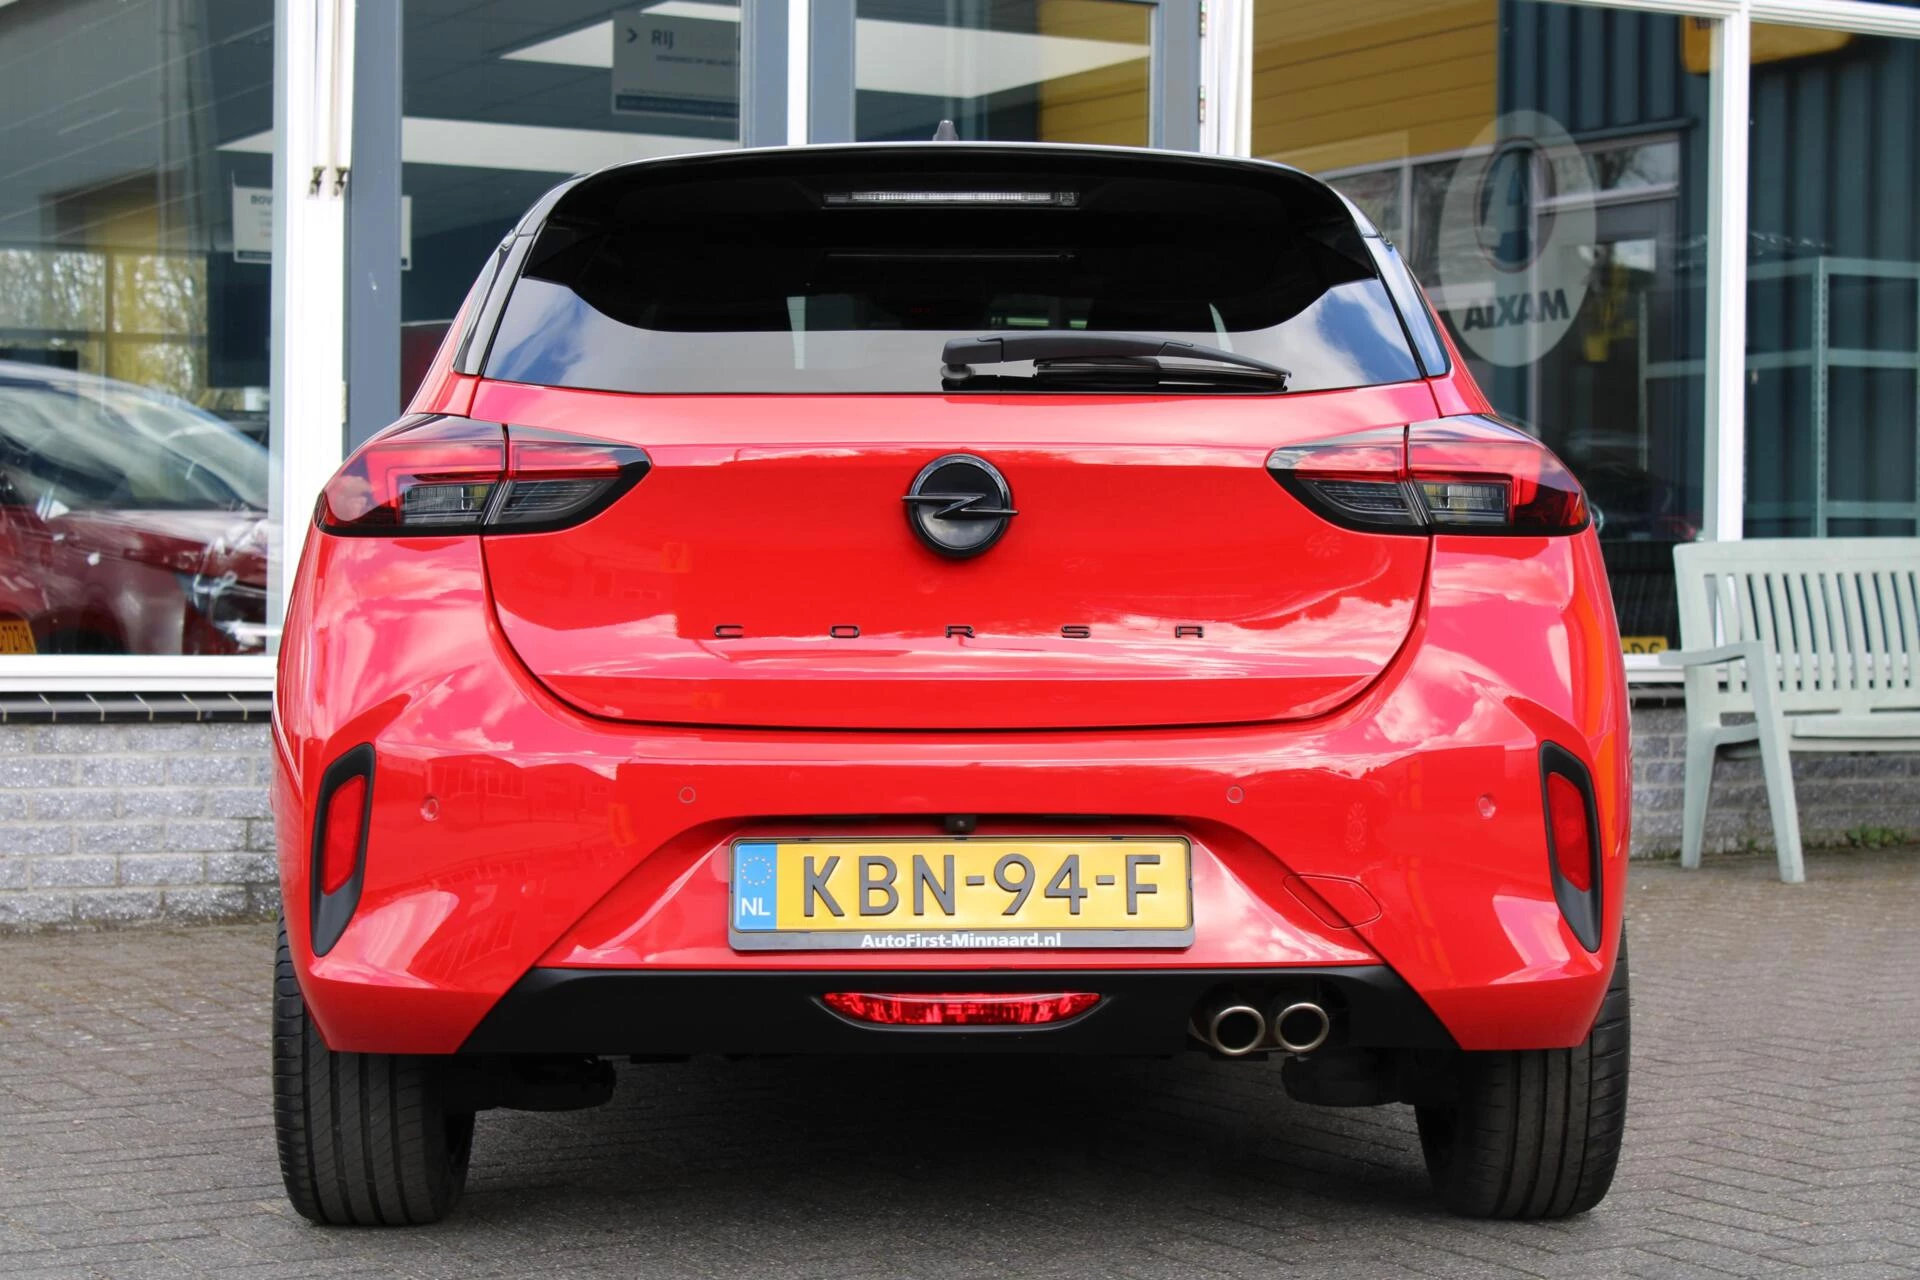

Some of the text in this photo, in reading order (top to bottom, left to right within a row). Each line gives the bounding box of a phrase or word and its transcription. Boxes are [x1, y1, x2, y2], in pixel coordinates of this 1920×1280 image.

[1463, 288, 1570, 331] AIXAM
[713, 624, 1205, 639] CORSA
[803, 853, 1161, 917] KBN-94-F
[741, 897, 771, 916] NL
[861, 932, 1062, 949] AutoFirst-Minnaard.nl
